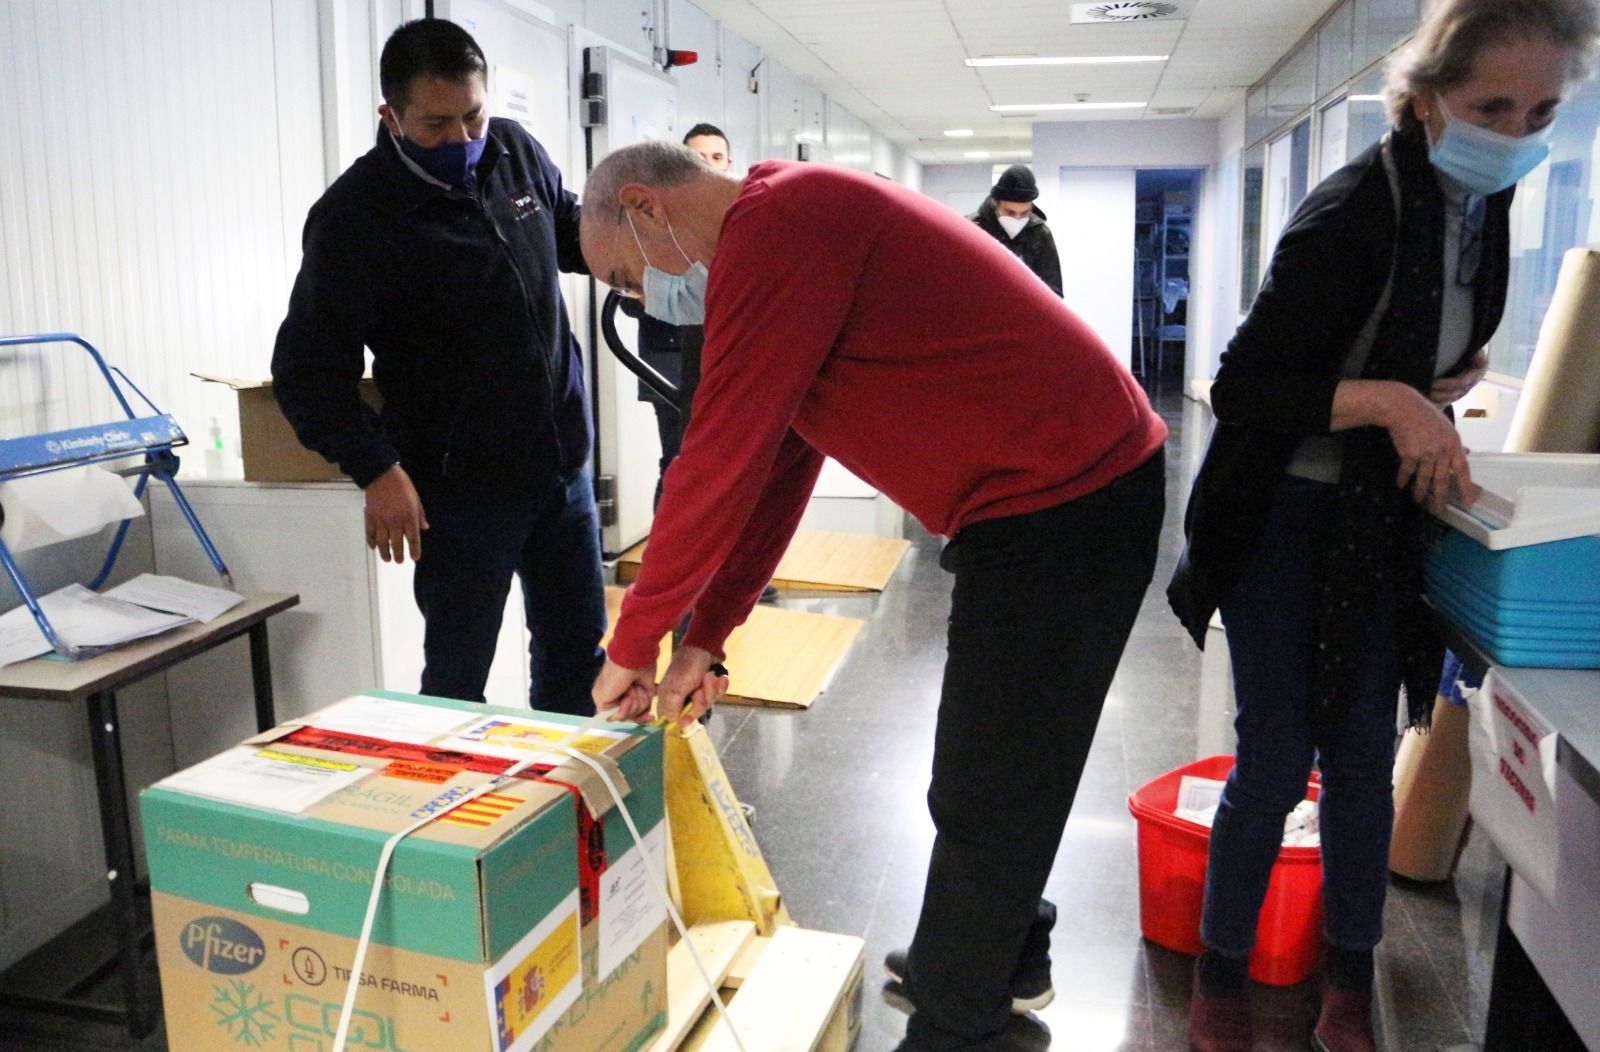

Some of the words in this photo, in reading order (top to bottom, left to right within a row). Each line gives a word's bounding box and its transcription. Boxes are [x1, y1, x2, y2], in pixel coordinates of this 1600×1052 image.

[212, 836, 330, 877] TEMPERATURA
[333, 863, 455, 901] CONROLADA
[187, 922, 264, 972] Pfizer
[381, 978, 439, 1001] FARMA
